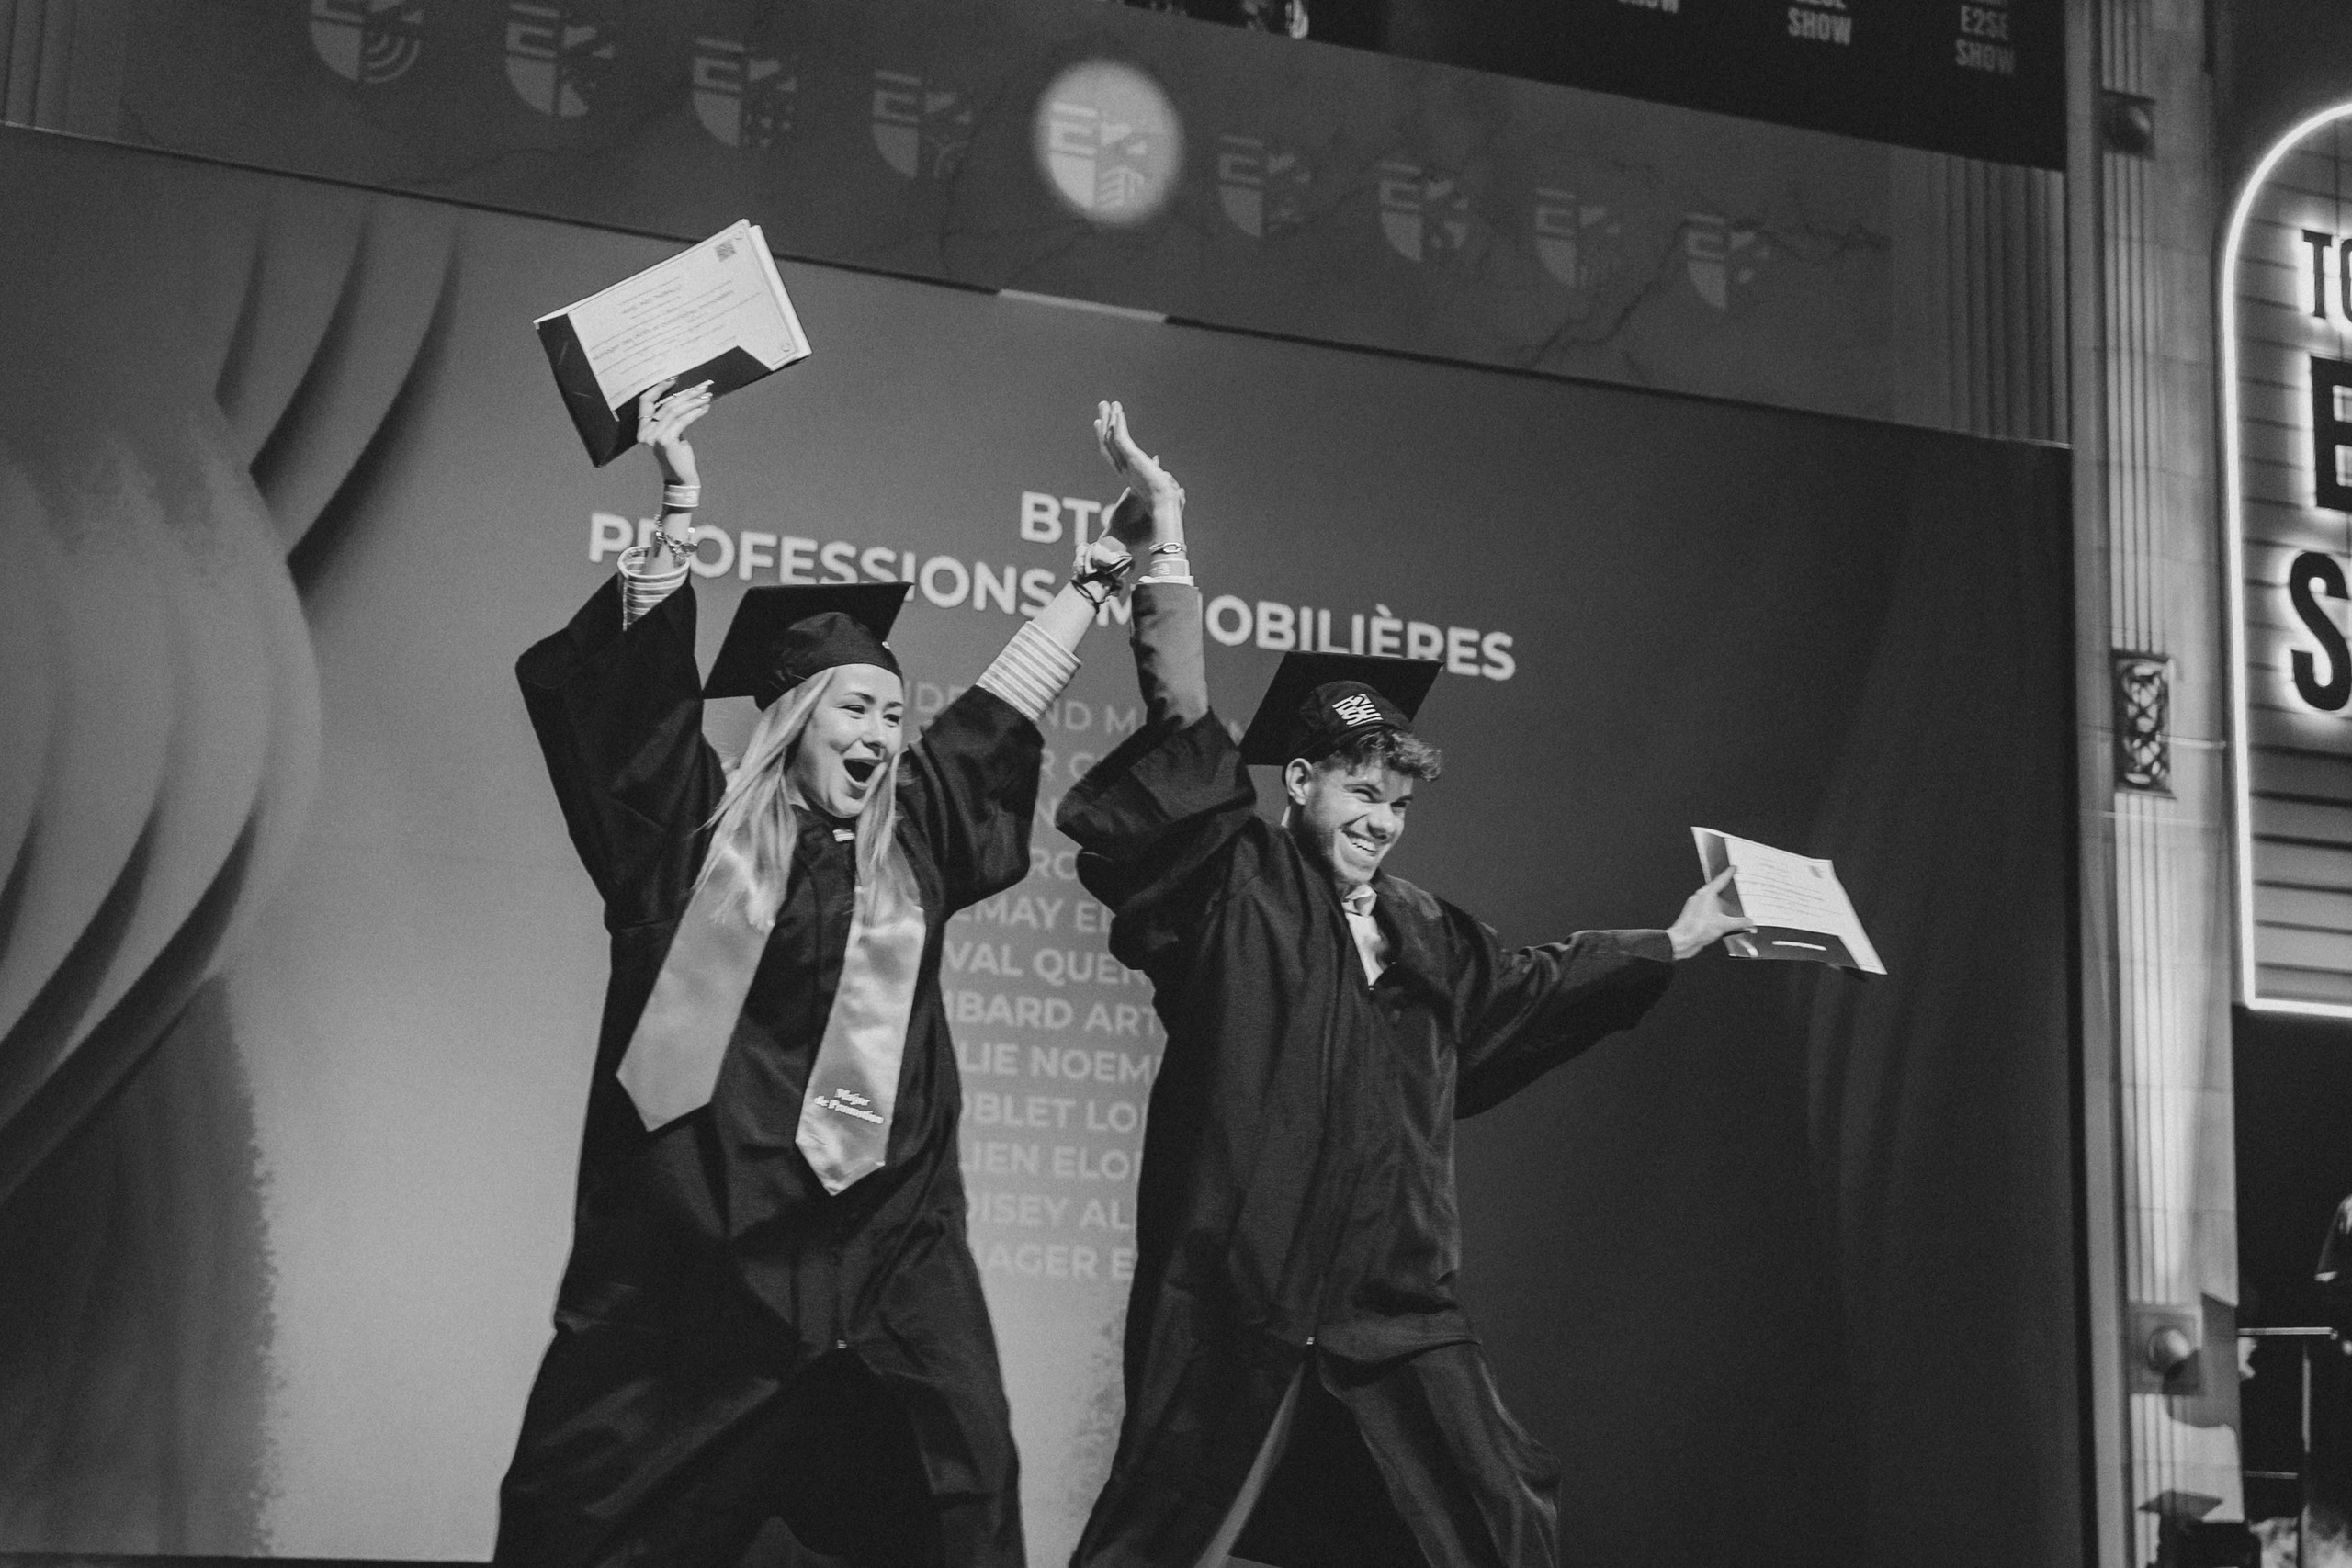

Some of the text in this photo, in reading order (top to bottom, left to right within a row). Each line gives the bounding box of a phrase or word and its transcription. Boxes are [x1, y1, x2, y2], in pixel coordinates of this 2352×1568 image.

[1787, 7, 1852, 45] SHOW
[1960, 5, 2009, 40] E2SE
[1955, 39, 2016, 75] SHOW
[1020, 490, 1116, 546] BT
[944, 989, 1074, 1031] BARD
[1030, 1045, 1161, 1086] NOEM
[1052, 1145, 1141, 1182] ELO
[975, 1240, 1098, 1280] AGER
